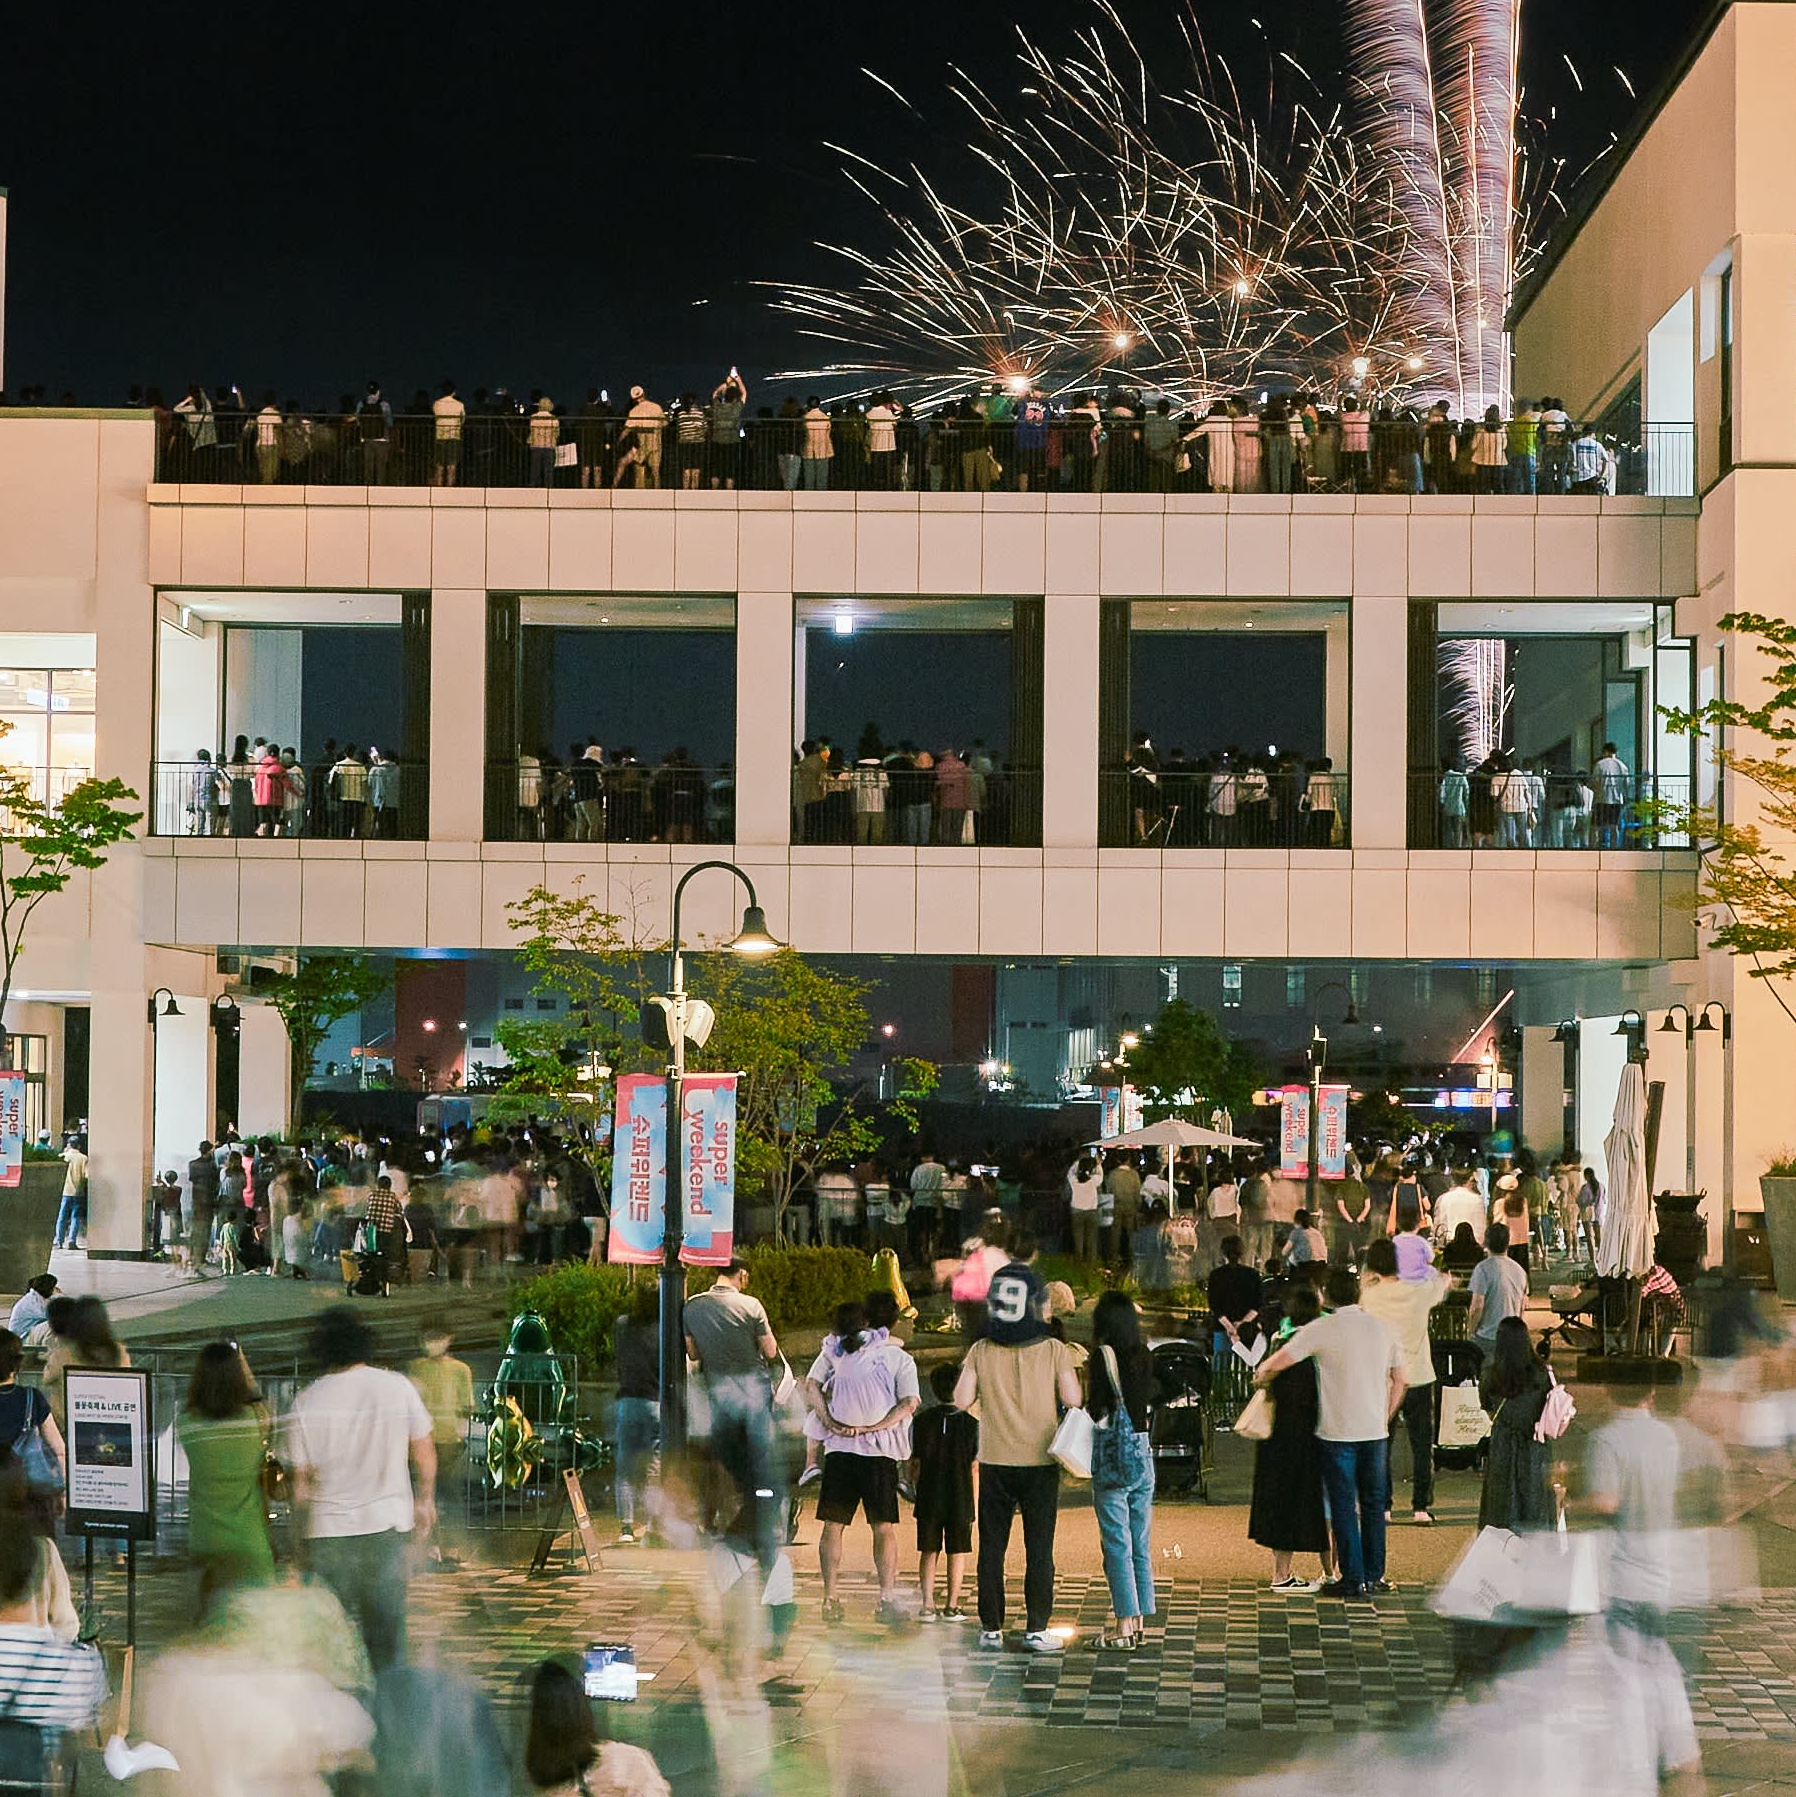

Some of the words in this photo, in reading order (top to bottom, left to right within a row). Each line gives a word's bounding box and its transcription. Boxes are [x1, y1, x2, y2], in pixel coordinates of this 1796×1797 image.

[5, 1098, 20, 1138] super
[1284, 1102, 1298, 1154] weekend
[1295, 1108, 1306, 1139] super
[629, 1114, 651, 1222] 슈퍼위켄드
[689, 1109, 712, 1216] weekend
[707, 1121, 729, 1186] super
[998, 1278, 1028, 1322] 9
